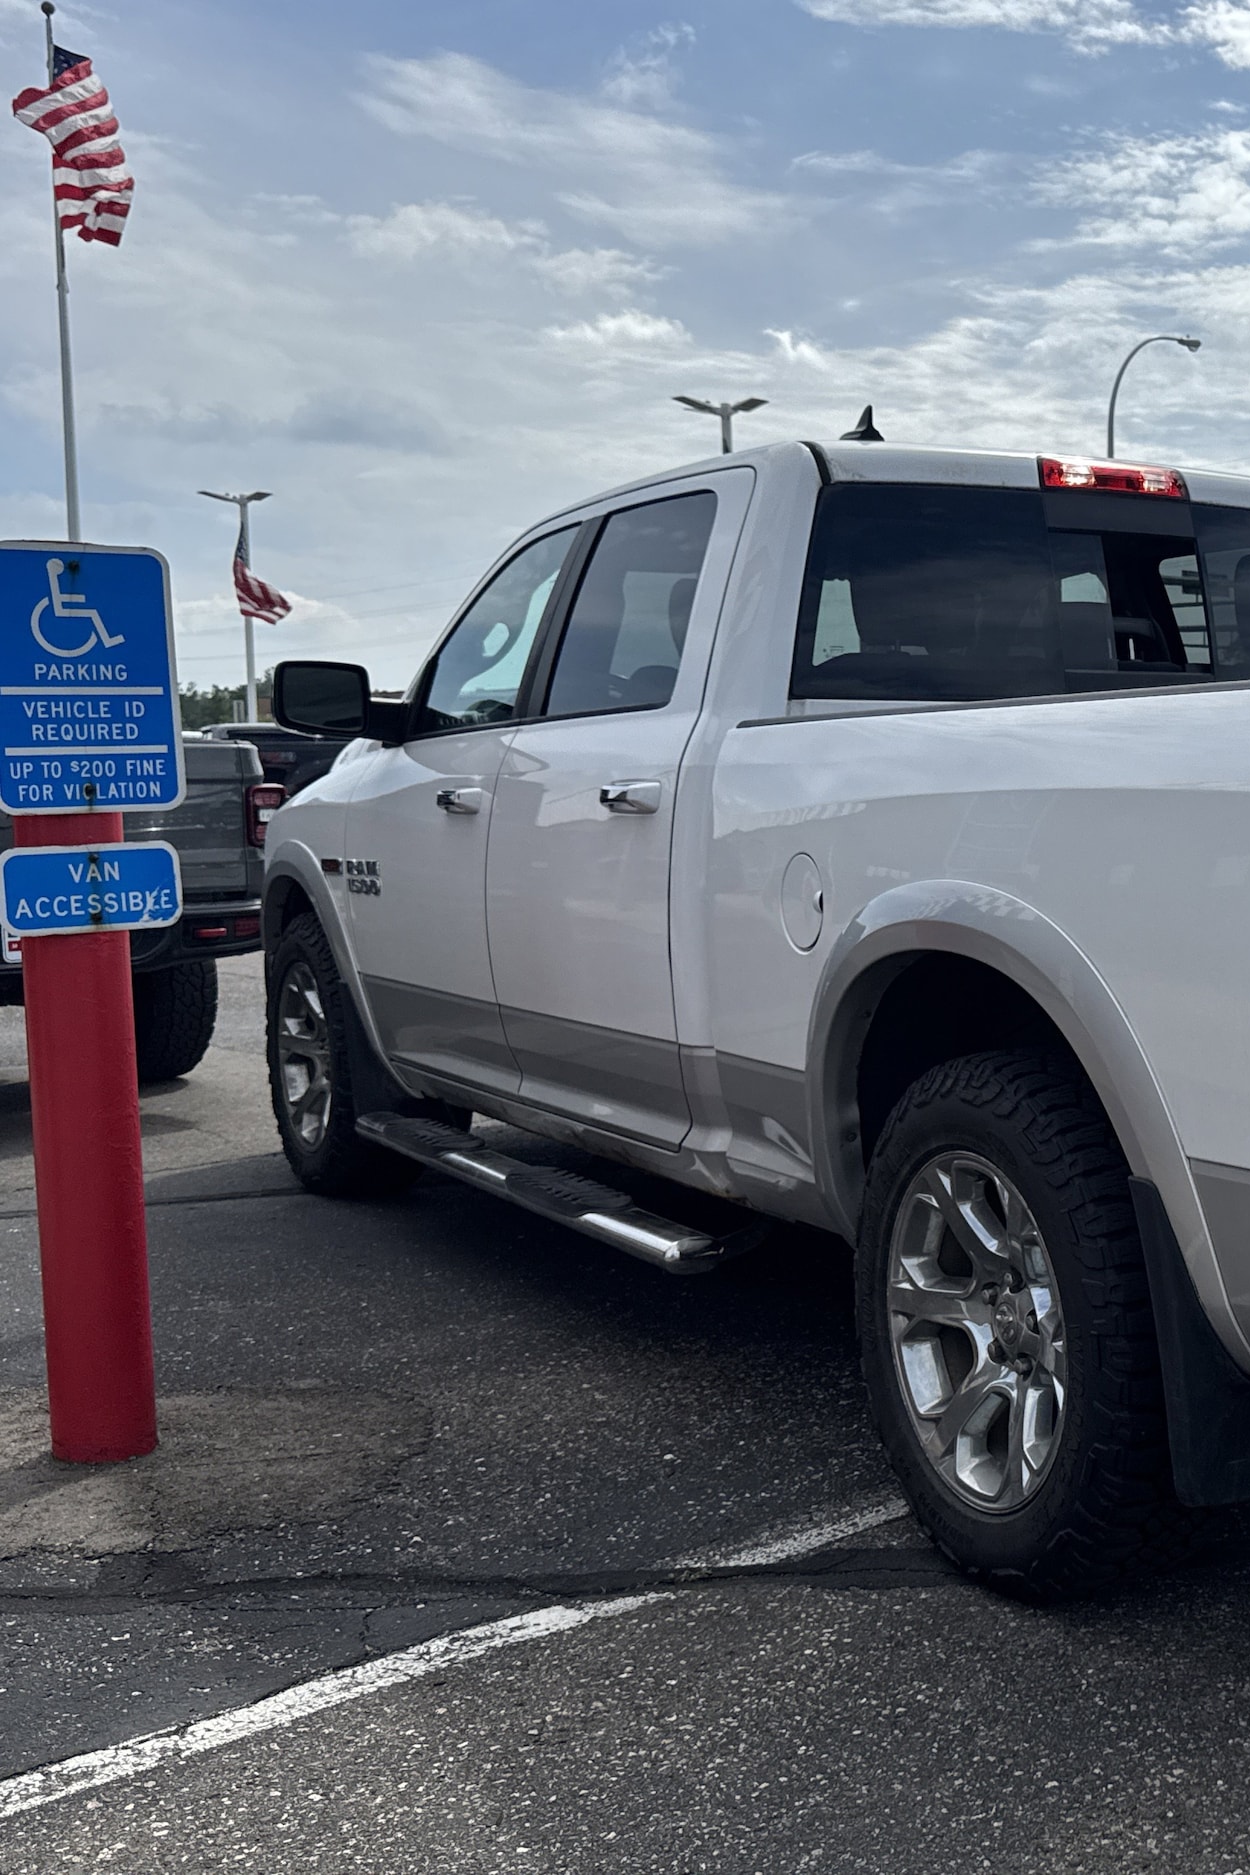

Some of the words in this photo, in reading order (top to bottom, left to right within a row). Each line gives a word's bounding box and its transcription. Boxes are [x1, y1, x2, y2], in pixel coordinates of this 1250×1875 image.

[34, 664, 128, 681] PARKING
[23, 701, 112, 719] VEHICLE
[124, 702, 145, 718] ID
[32, 723, 139, 741] REQUIRED
[10, 762, 34, 779] UP
[41, 761, 62, 778] TO
[126, 759, 166, 777] FINE
[18, 784, 53, 801] FOR
[63, 781, 161, 800] VIOLATION
[68, 861, 120, 883] VAN
[15, 889, 173, 920] ACCESSIBLE
